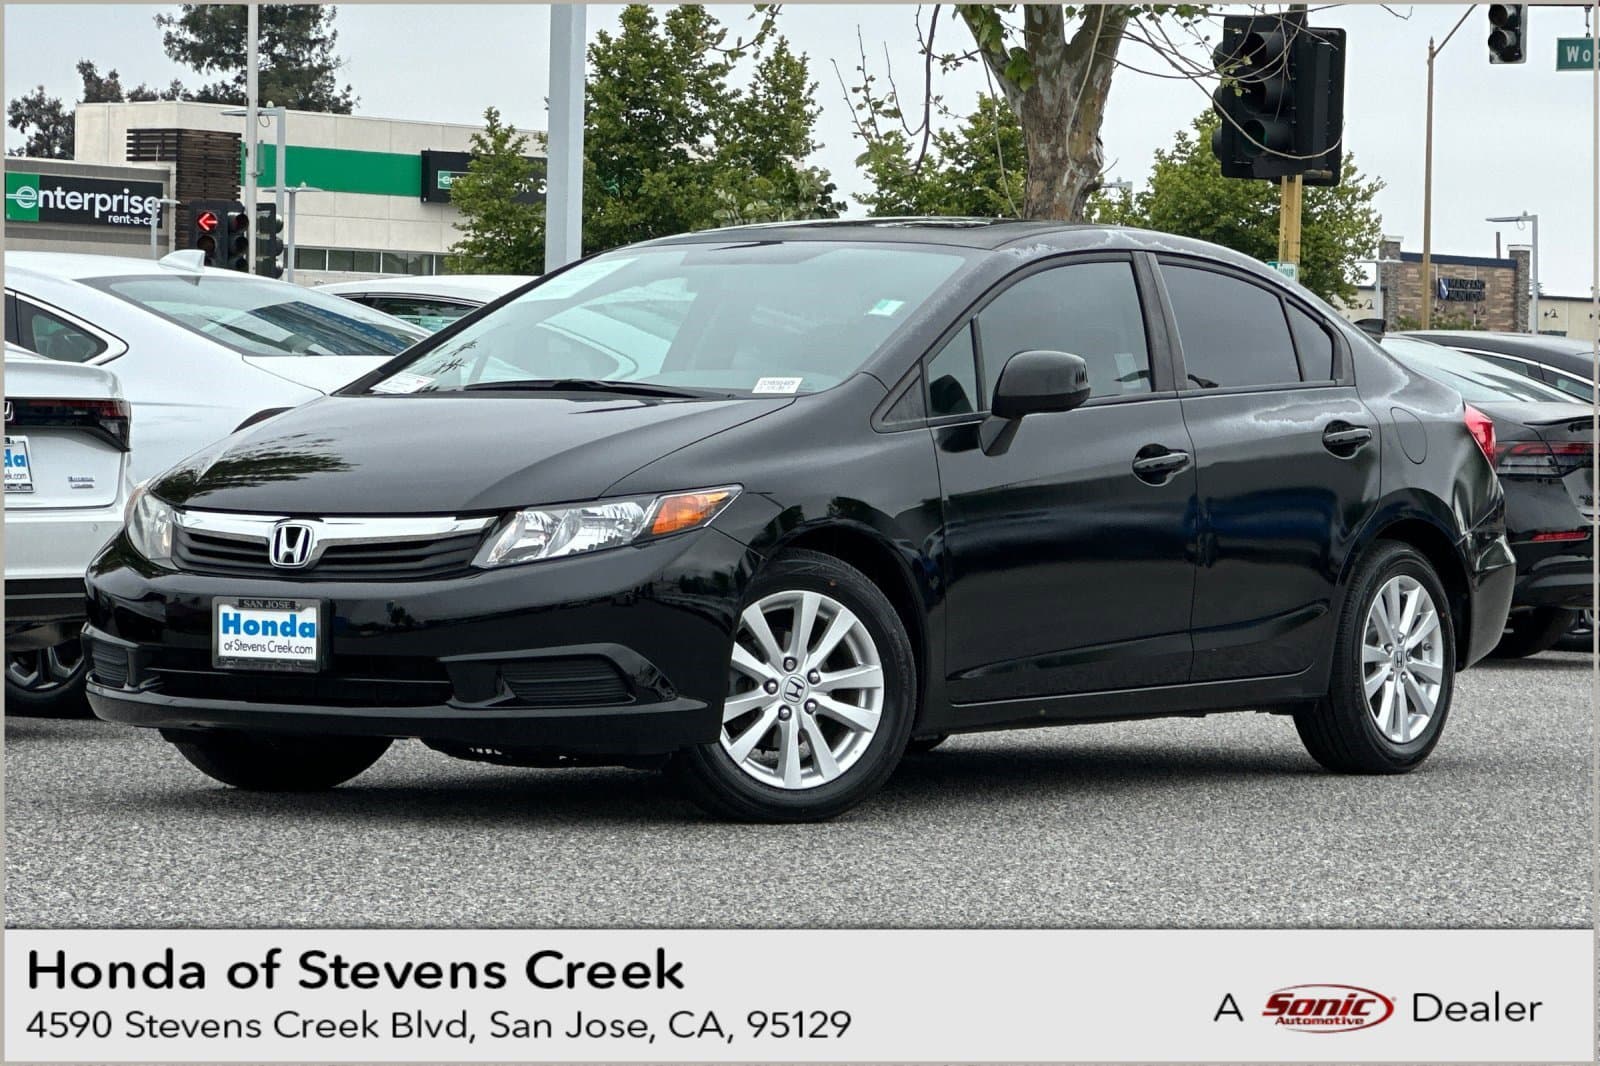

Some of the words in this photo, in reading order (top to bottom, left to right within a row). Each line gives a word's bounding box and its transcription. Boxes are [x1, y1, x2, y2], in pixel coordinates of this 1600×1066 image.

[1566, 46, 1600, 62] Wo
[15, 186, 160, 218] enterprise
[243, 600, 264, 608] SAN
[265, 601, 291, 609] JOSE
[222, 612, 316, 638] Honda
[224, 639, 234, 651] of
[234, 639, 267, 653] Stevens
[267, 640, 313, 655] Creek.com
